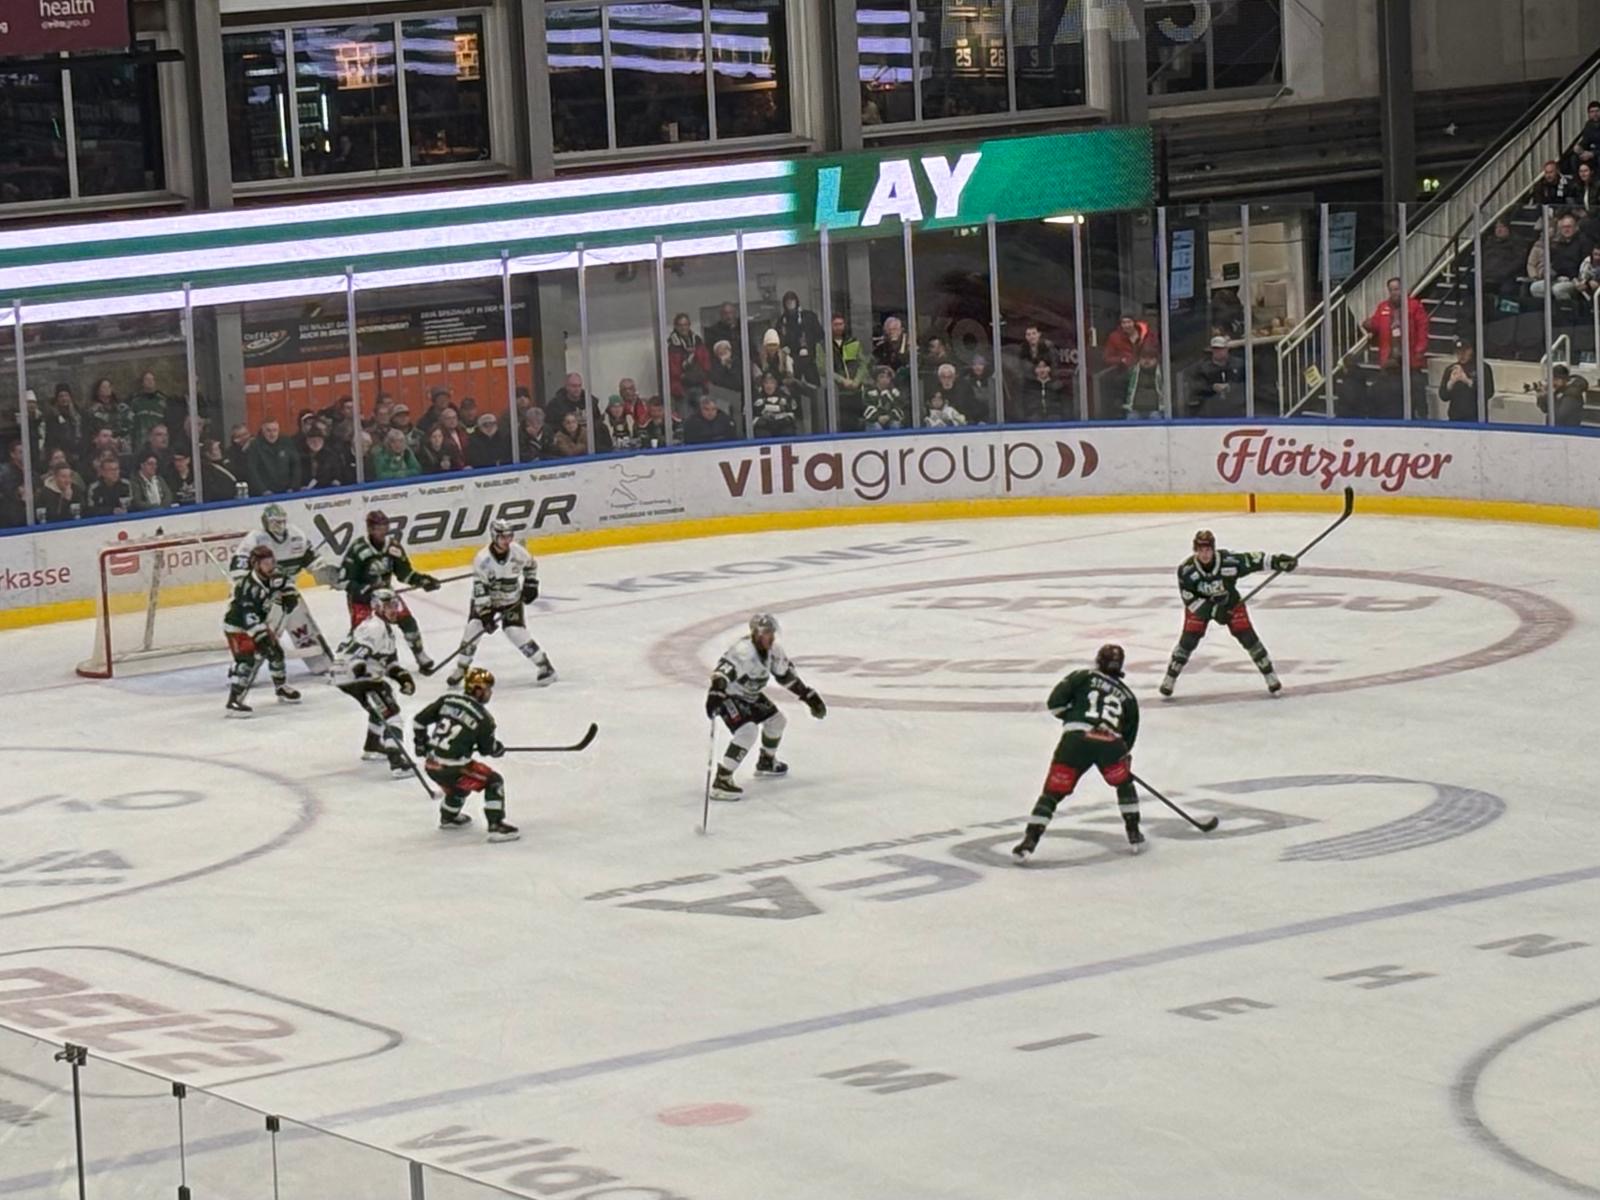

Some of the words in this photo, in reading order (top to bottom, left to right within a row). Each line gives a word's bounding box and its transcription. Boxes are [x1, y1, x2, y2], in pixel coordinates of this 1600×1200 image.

[40, 0, 95, 17] health
[955, 48, 972, 67] 25
[815, 152, 982, 230] LAY
[718, 441, 1044, 501] vitagroup
[1217, 428, 1453, 492] Flötzinger
[588, 536, 971, 593] KRONES
[891, 593, 1441, 613] Agnda:
[1084, 689, 1123, 728] 12
